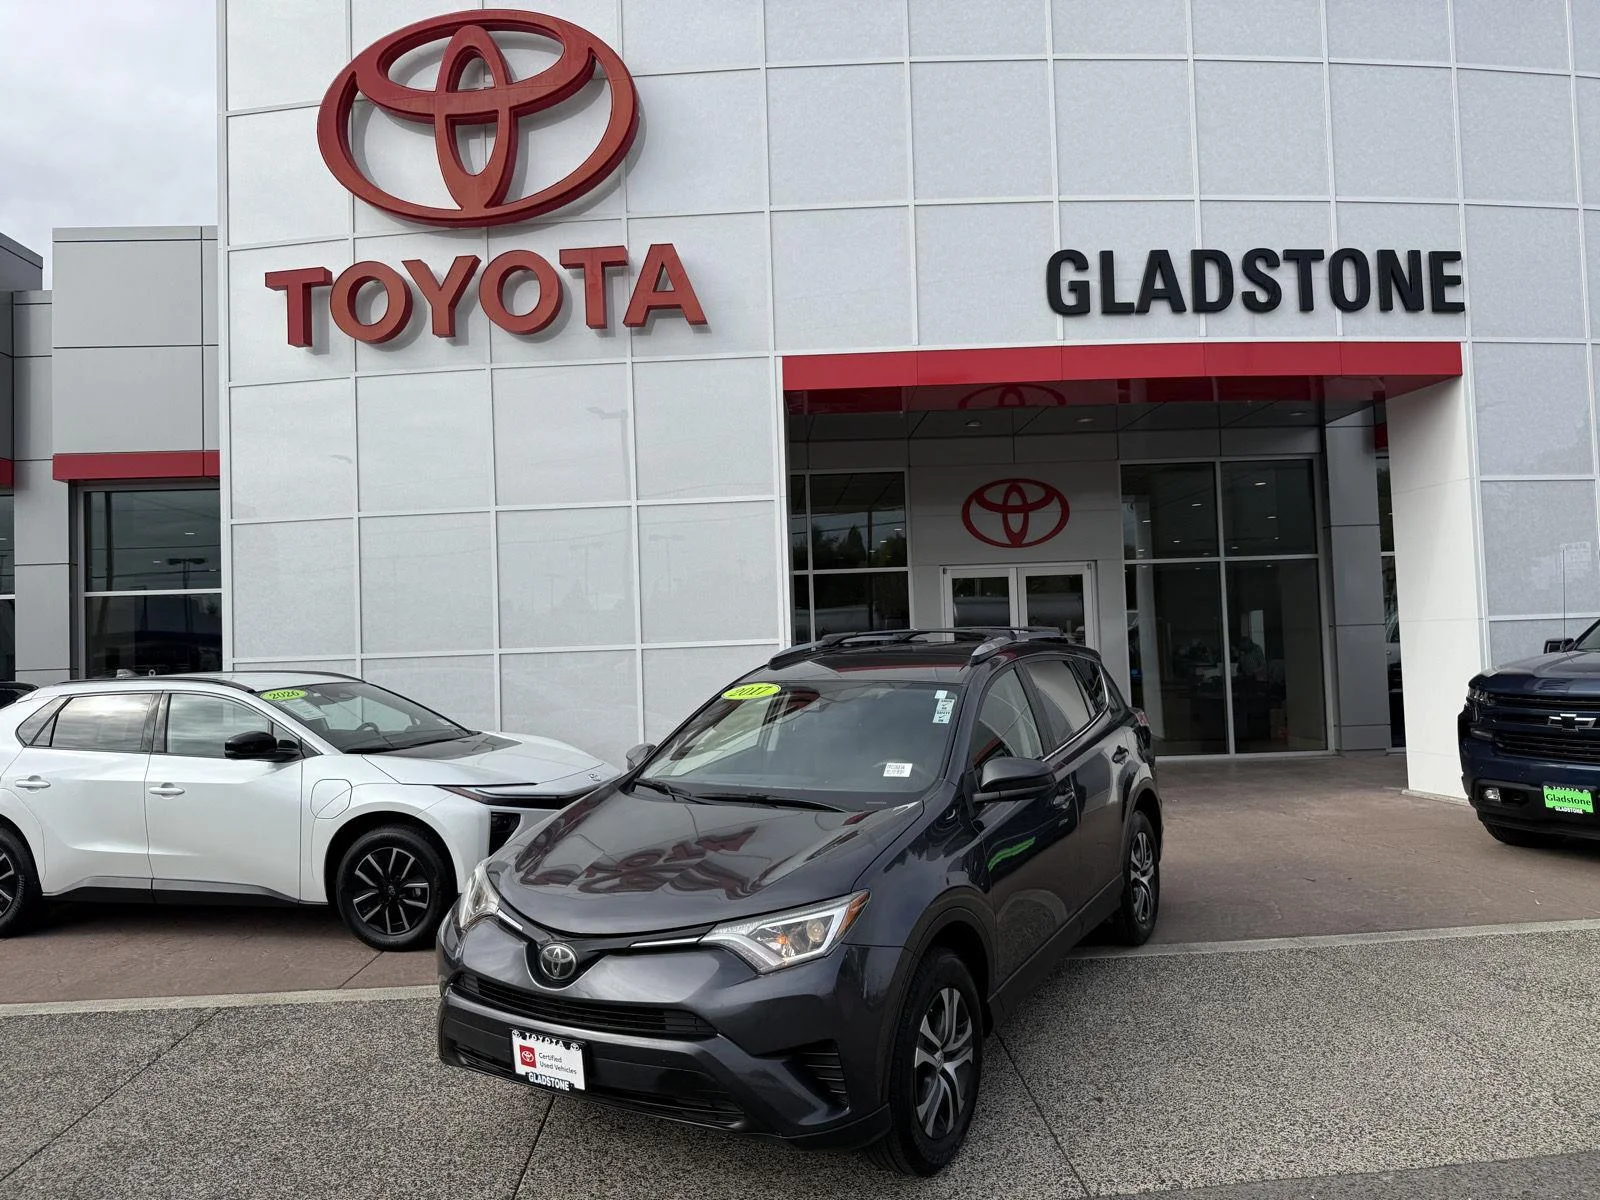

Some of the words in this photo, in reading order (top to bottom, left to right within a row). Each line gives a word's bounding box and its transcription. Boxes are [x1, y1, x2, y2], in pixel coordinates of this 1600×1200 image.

[1046, 248, 1466, 315] GLADSTONE
[264, 243, 708, 348] TOYOTA
[268, 690, 300, 700] 2026
[728, 685, 773, 697] 2017
[1545, 793, 1592, 806] Gladstone
[525, 1032, 564, 1048] TOYOTA
[538, 1052, 563, 1063] Certified
[539, 1060, 554, 1070] Used
[554, 1064, 577, 1075] Vehicles
[528, 1071, 570, 1092] GLADSTONE
